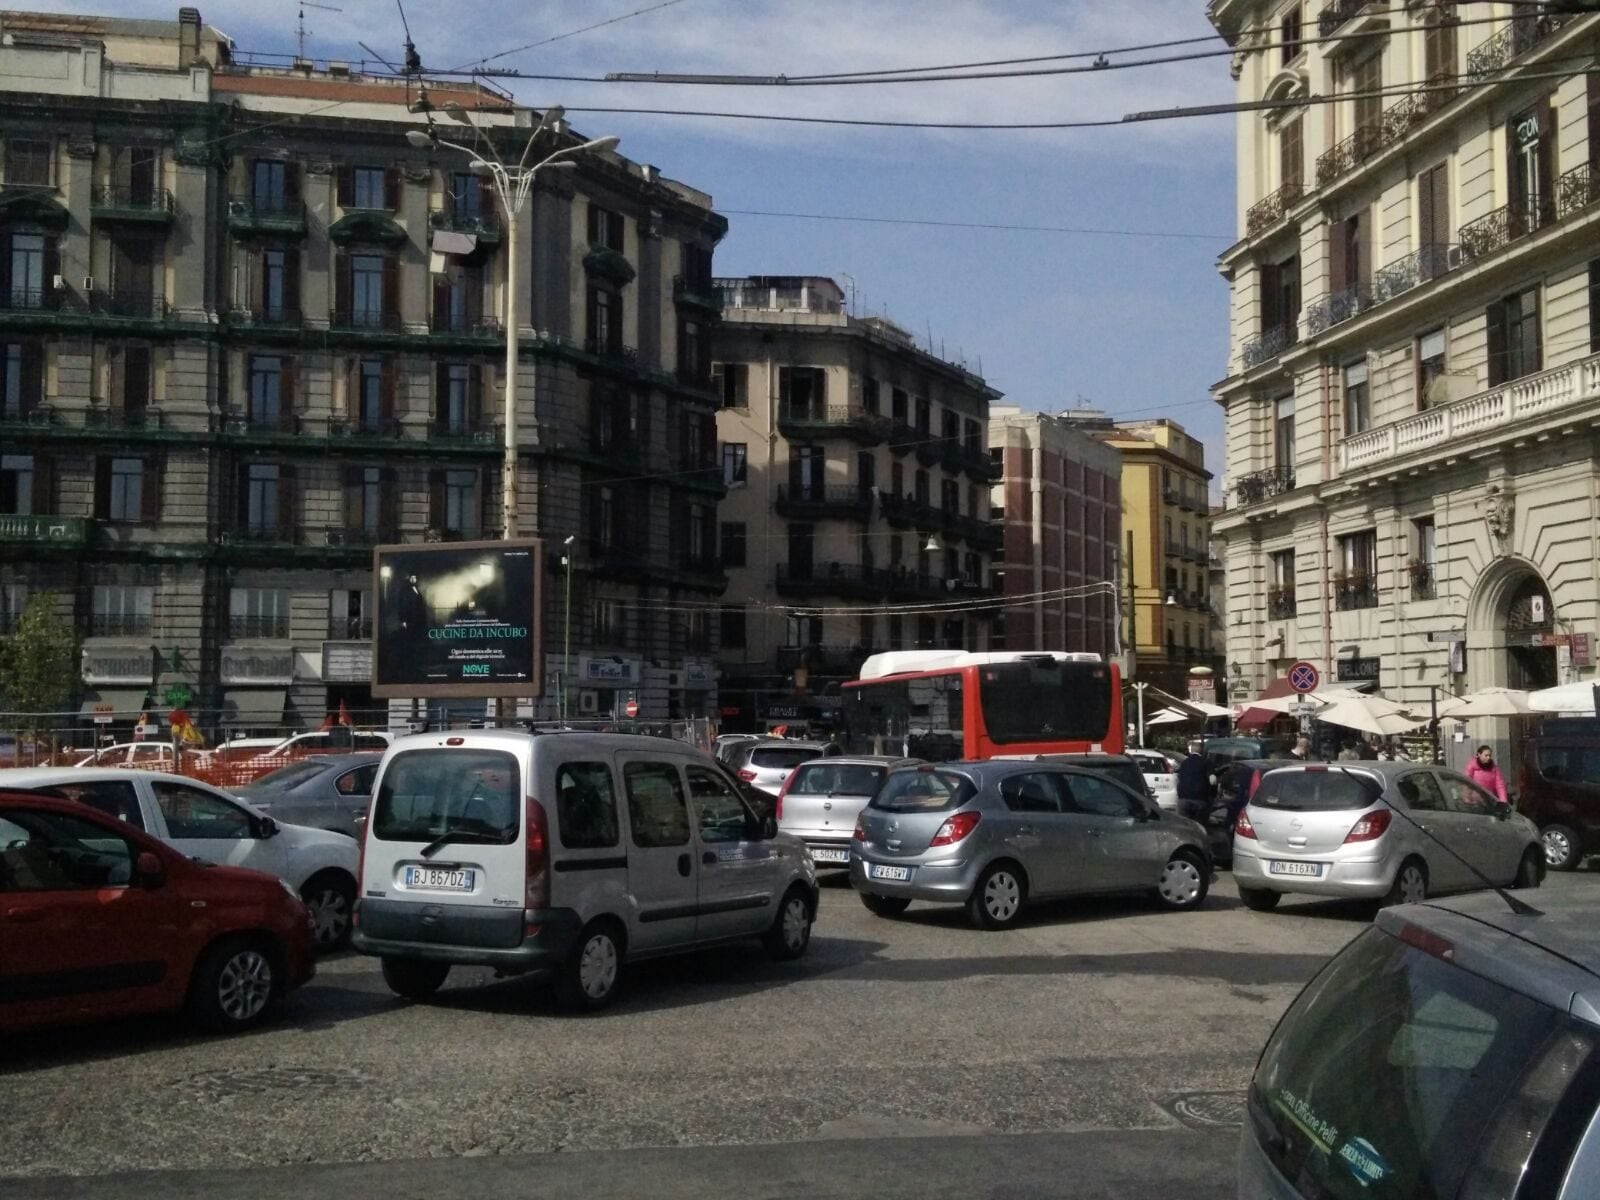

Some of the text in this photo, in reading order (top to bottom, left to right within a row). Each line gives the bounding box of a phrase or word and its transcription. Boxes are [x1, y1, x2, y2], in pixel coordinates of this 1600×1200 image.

[428, 627, 527, 639] CUCINE DA INCUBO
[463, 664, 490, 673] NOVE
[1338, 661, 1379, 676] PELLONE
[1275, 862, 1317, 875] DN 616XN
[413, 870, 466, 887] BJ 867DZ
[1295, 1099, 1320, 1132] Officine
[1319, 1120, 1338, 1146] Pelli
